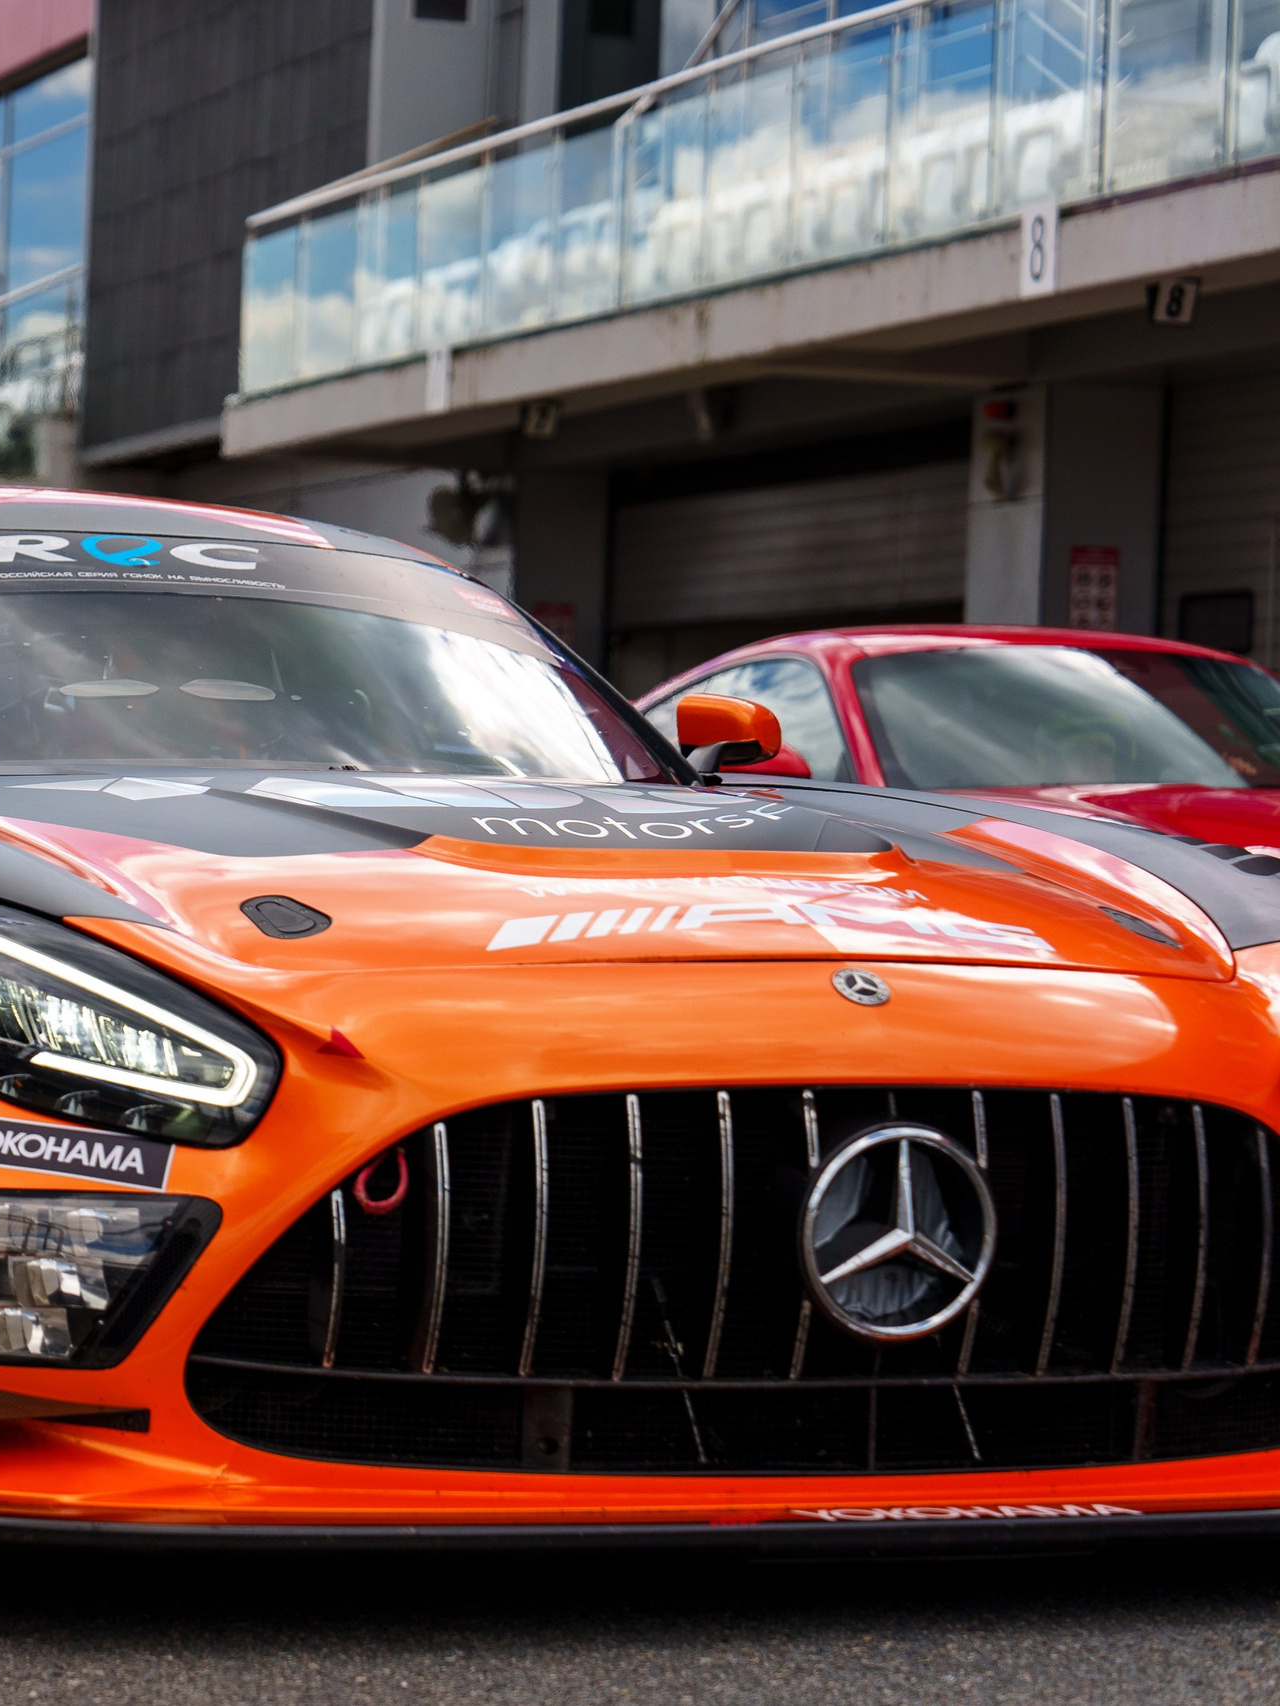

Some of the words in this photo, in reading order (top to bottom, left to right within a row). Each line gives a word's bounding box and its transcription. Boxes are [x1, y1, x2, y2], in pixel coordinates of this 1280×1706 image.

[1029, 215, 1045, 283] 8
[1165, 284, 1185, 318] 8
[675, 902, 1057, 951] AMG
[790, 1502, 1144, 1522] YOKOHAMA
